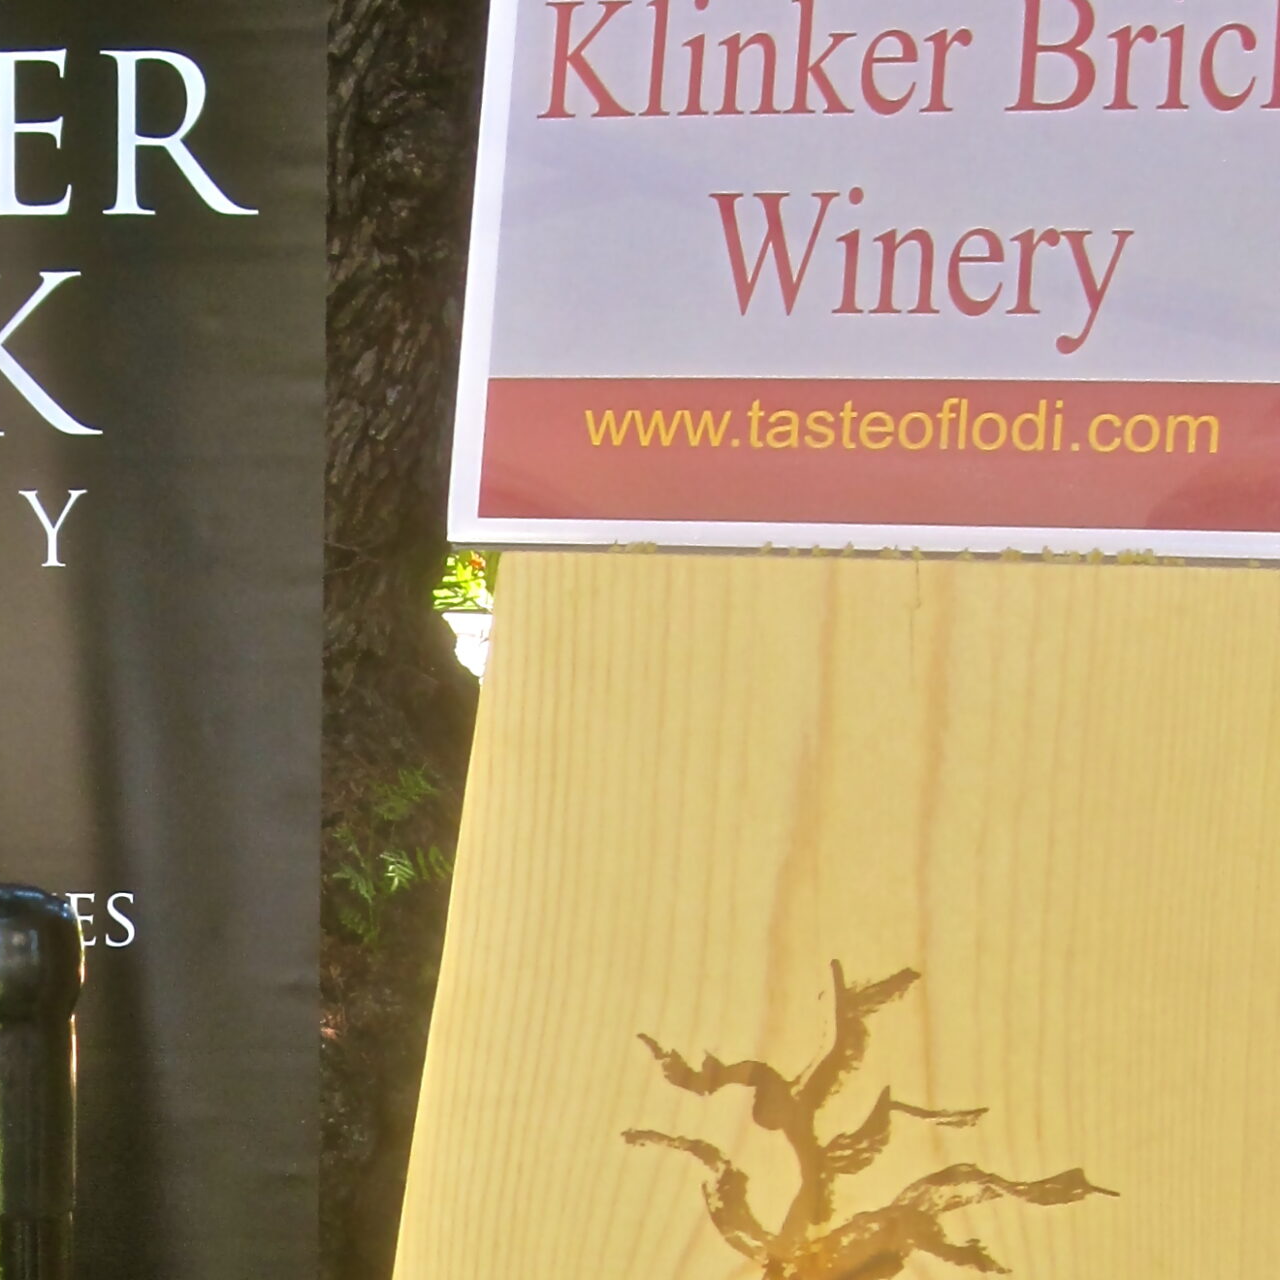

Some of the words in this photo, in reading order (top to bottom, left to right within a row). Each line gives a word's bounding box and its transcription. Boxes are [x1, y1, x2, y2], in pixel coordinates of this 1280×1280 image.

[537, 0, 973, 120] Klinker
[1005, 0, 1280, 113] Bric
[709, 187, 1134, 354] Winery
[585, 398, 1220, 454] www.tasteoflodi.com
